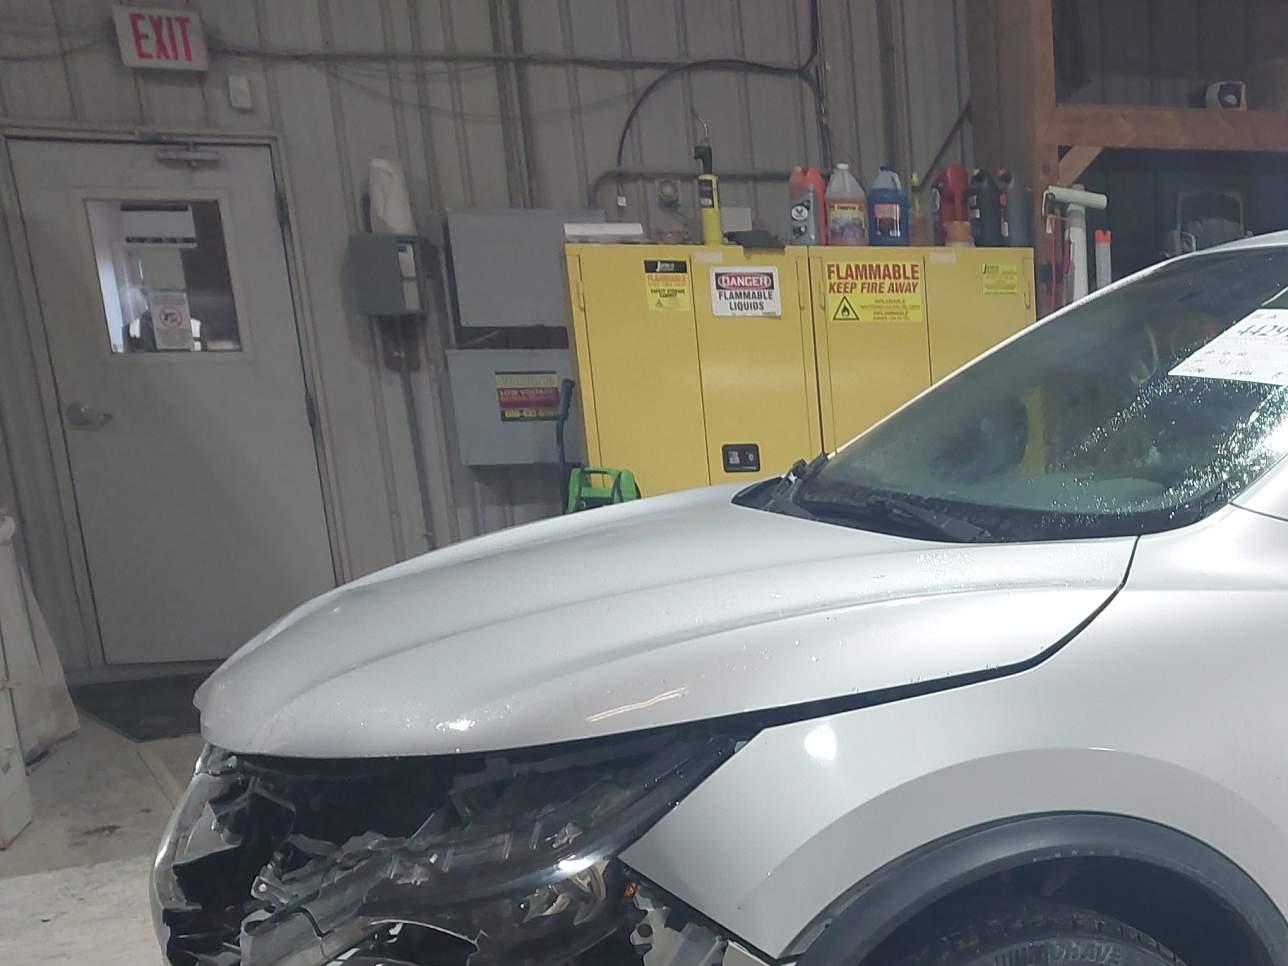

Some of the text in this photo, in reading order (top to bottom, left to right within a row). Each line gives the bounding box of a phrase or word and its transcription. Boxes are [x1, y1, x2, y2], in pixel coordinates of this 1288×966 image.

[129, 13, 193, 62] EXIT
[827, 263, 920, 281] FLAMMABLE
[721, 276, 769, 287] DANGER
[828, 281, 919, 294] KEEP FIRE AWAY
[718, 290, 773, 301] FLAMMABLE
[729, 301, 765, 311] LIQUIDS
